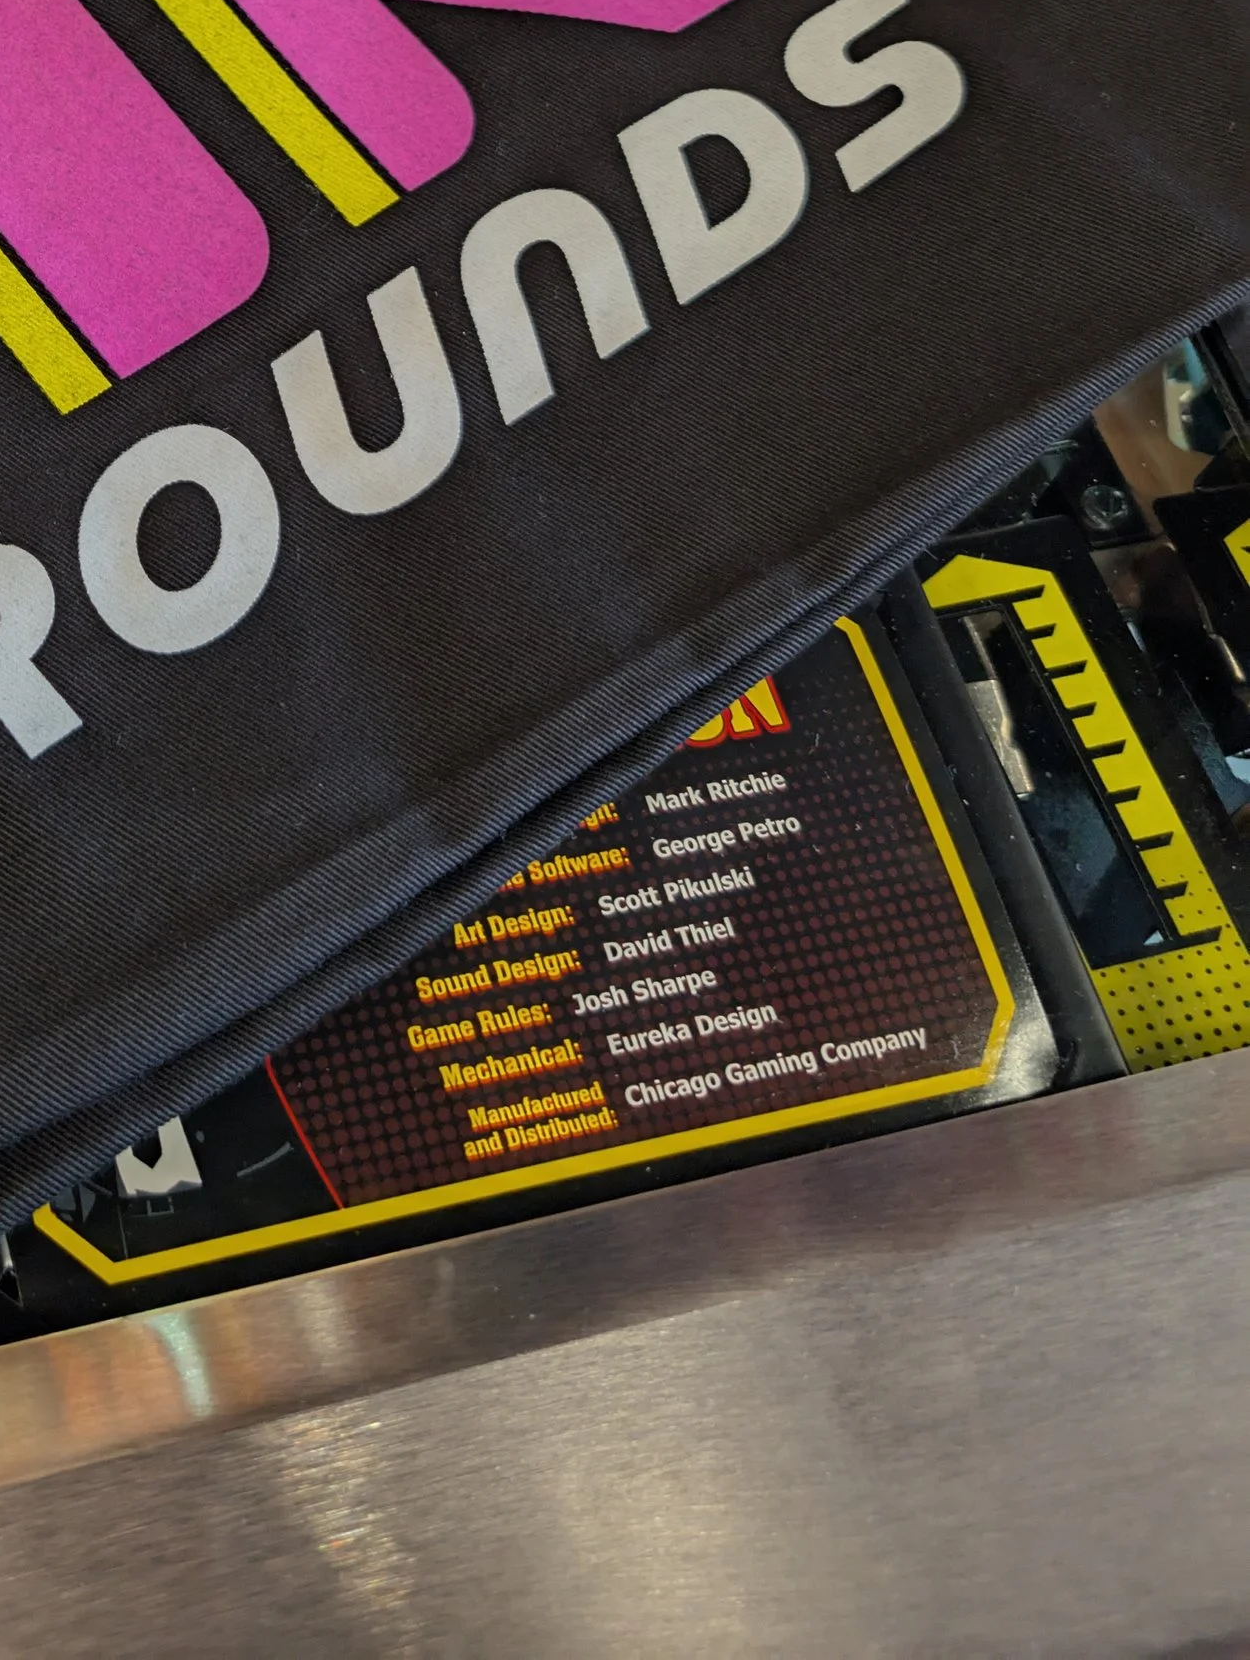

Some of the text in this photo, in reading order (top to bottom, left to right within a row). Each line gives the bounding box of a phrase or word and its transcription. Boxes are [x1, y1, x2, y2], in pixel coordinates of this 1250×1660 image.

[645, 786, 706, 815] Mark
[706, 771, 788, 803] Ritchie
[528, 845, 631, 886] Software:
[652, 828, 737, 859] George
[737, 815, 803, 843] Petro
[453, 866, 757, 950] Art Design: Scott Pikulski
[415, 916, 737, 1004] Sound Design: David Thiel
[406, 968, 718, 1054] Game Rules: Josh Sharpe
[439, 1002, 779, 1092] Mechanical: Eureka Design
[467, 1079, 607, 1134] Manufactured
[624, 1026, 928, 1109] Chicago Gaming Company
[463, 1106, 621, 1163] and Distributed:
